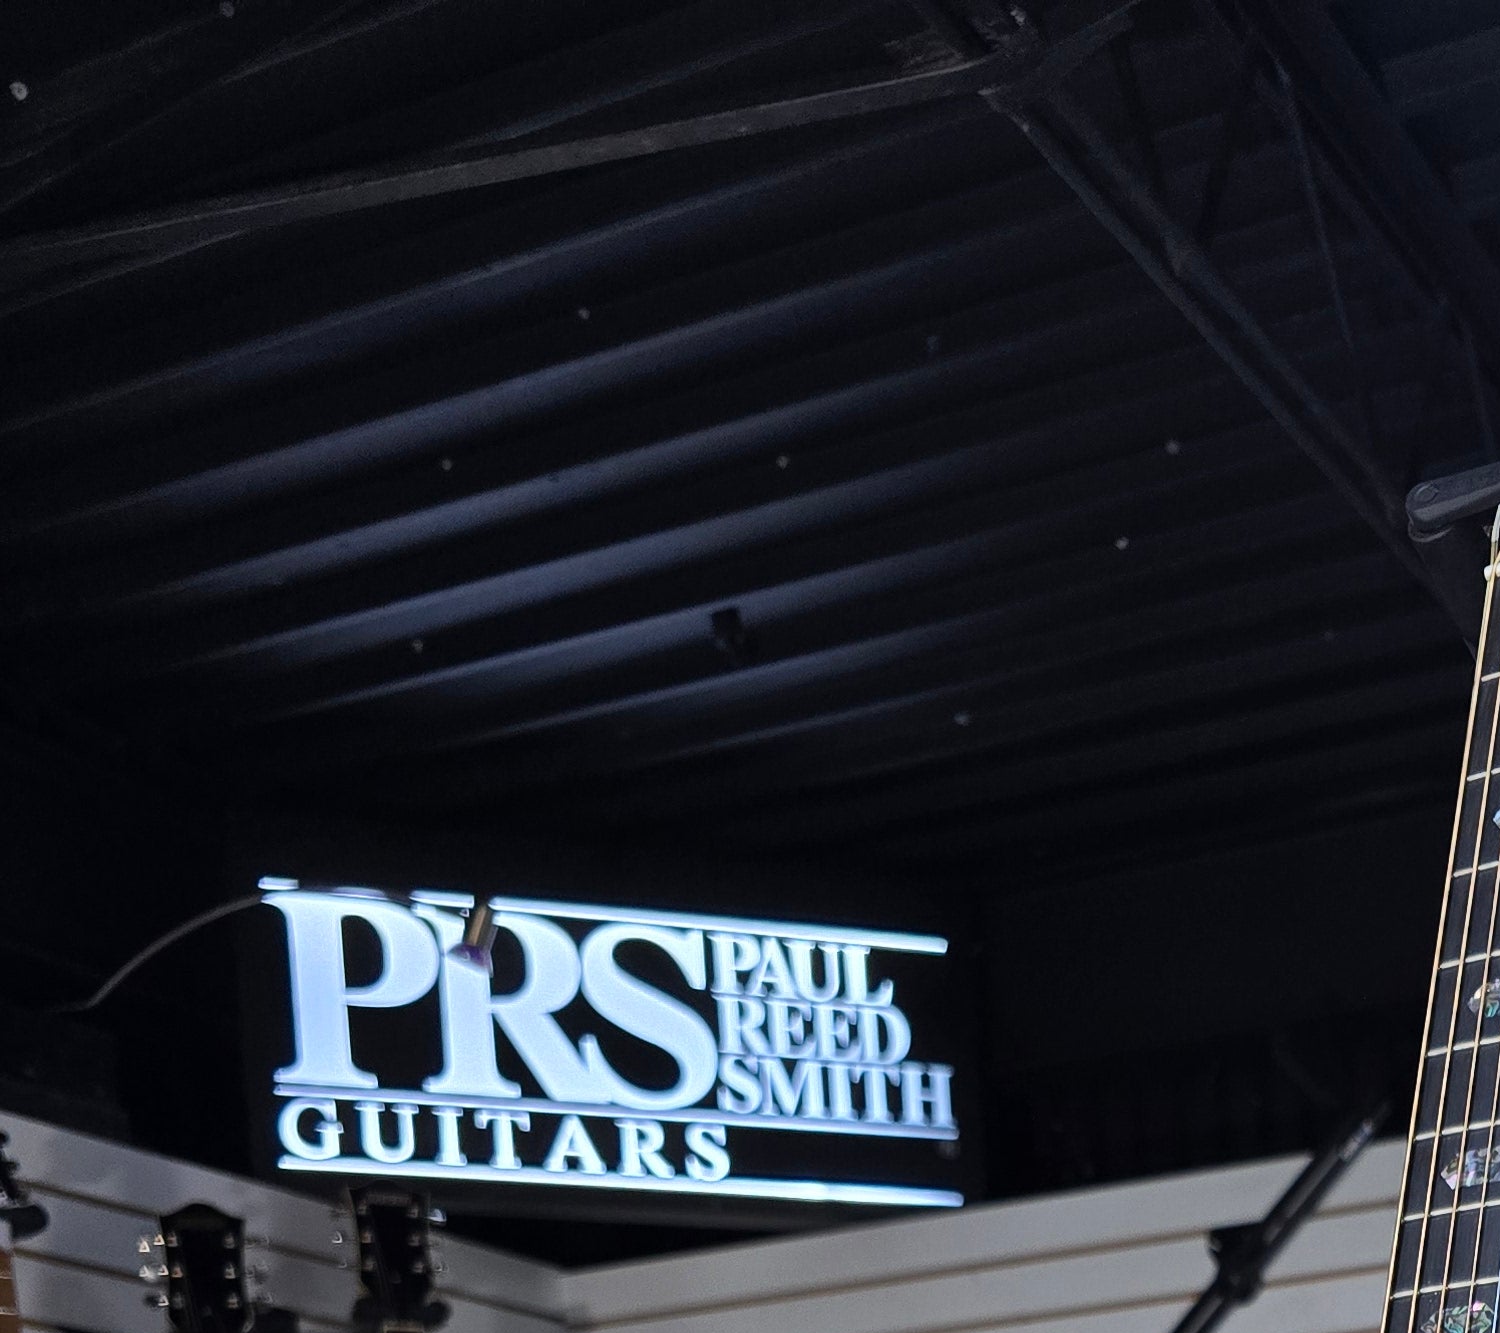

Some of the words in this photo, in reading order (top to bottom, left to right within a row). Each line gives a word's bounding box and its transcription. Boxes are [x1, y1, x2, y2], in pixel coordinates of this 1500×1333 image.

[261, 890, 719, 1111] PRS
[708, 931, 894, 1006] PAUL
[713, 992, 912, 1065] REED
[717, 1053, 957, 1131] SMITH
[278, 1097, 732, 1181] GUITARS
